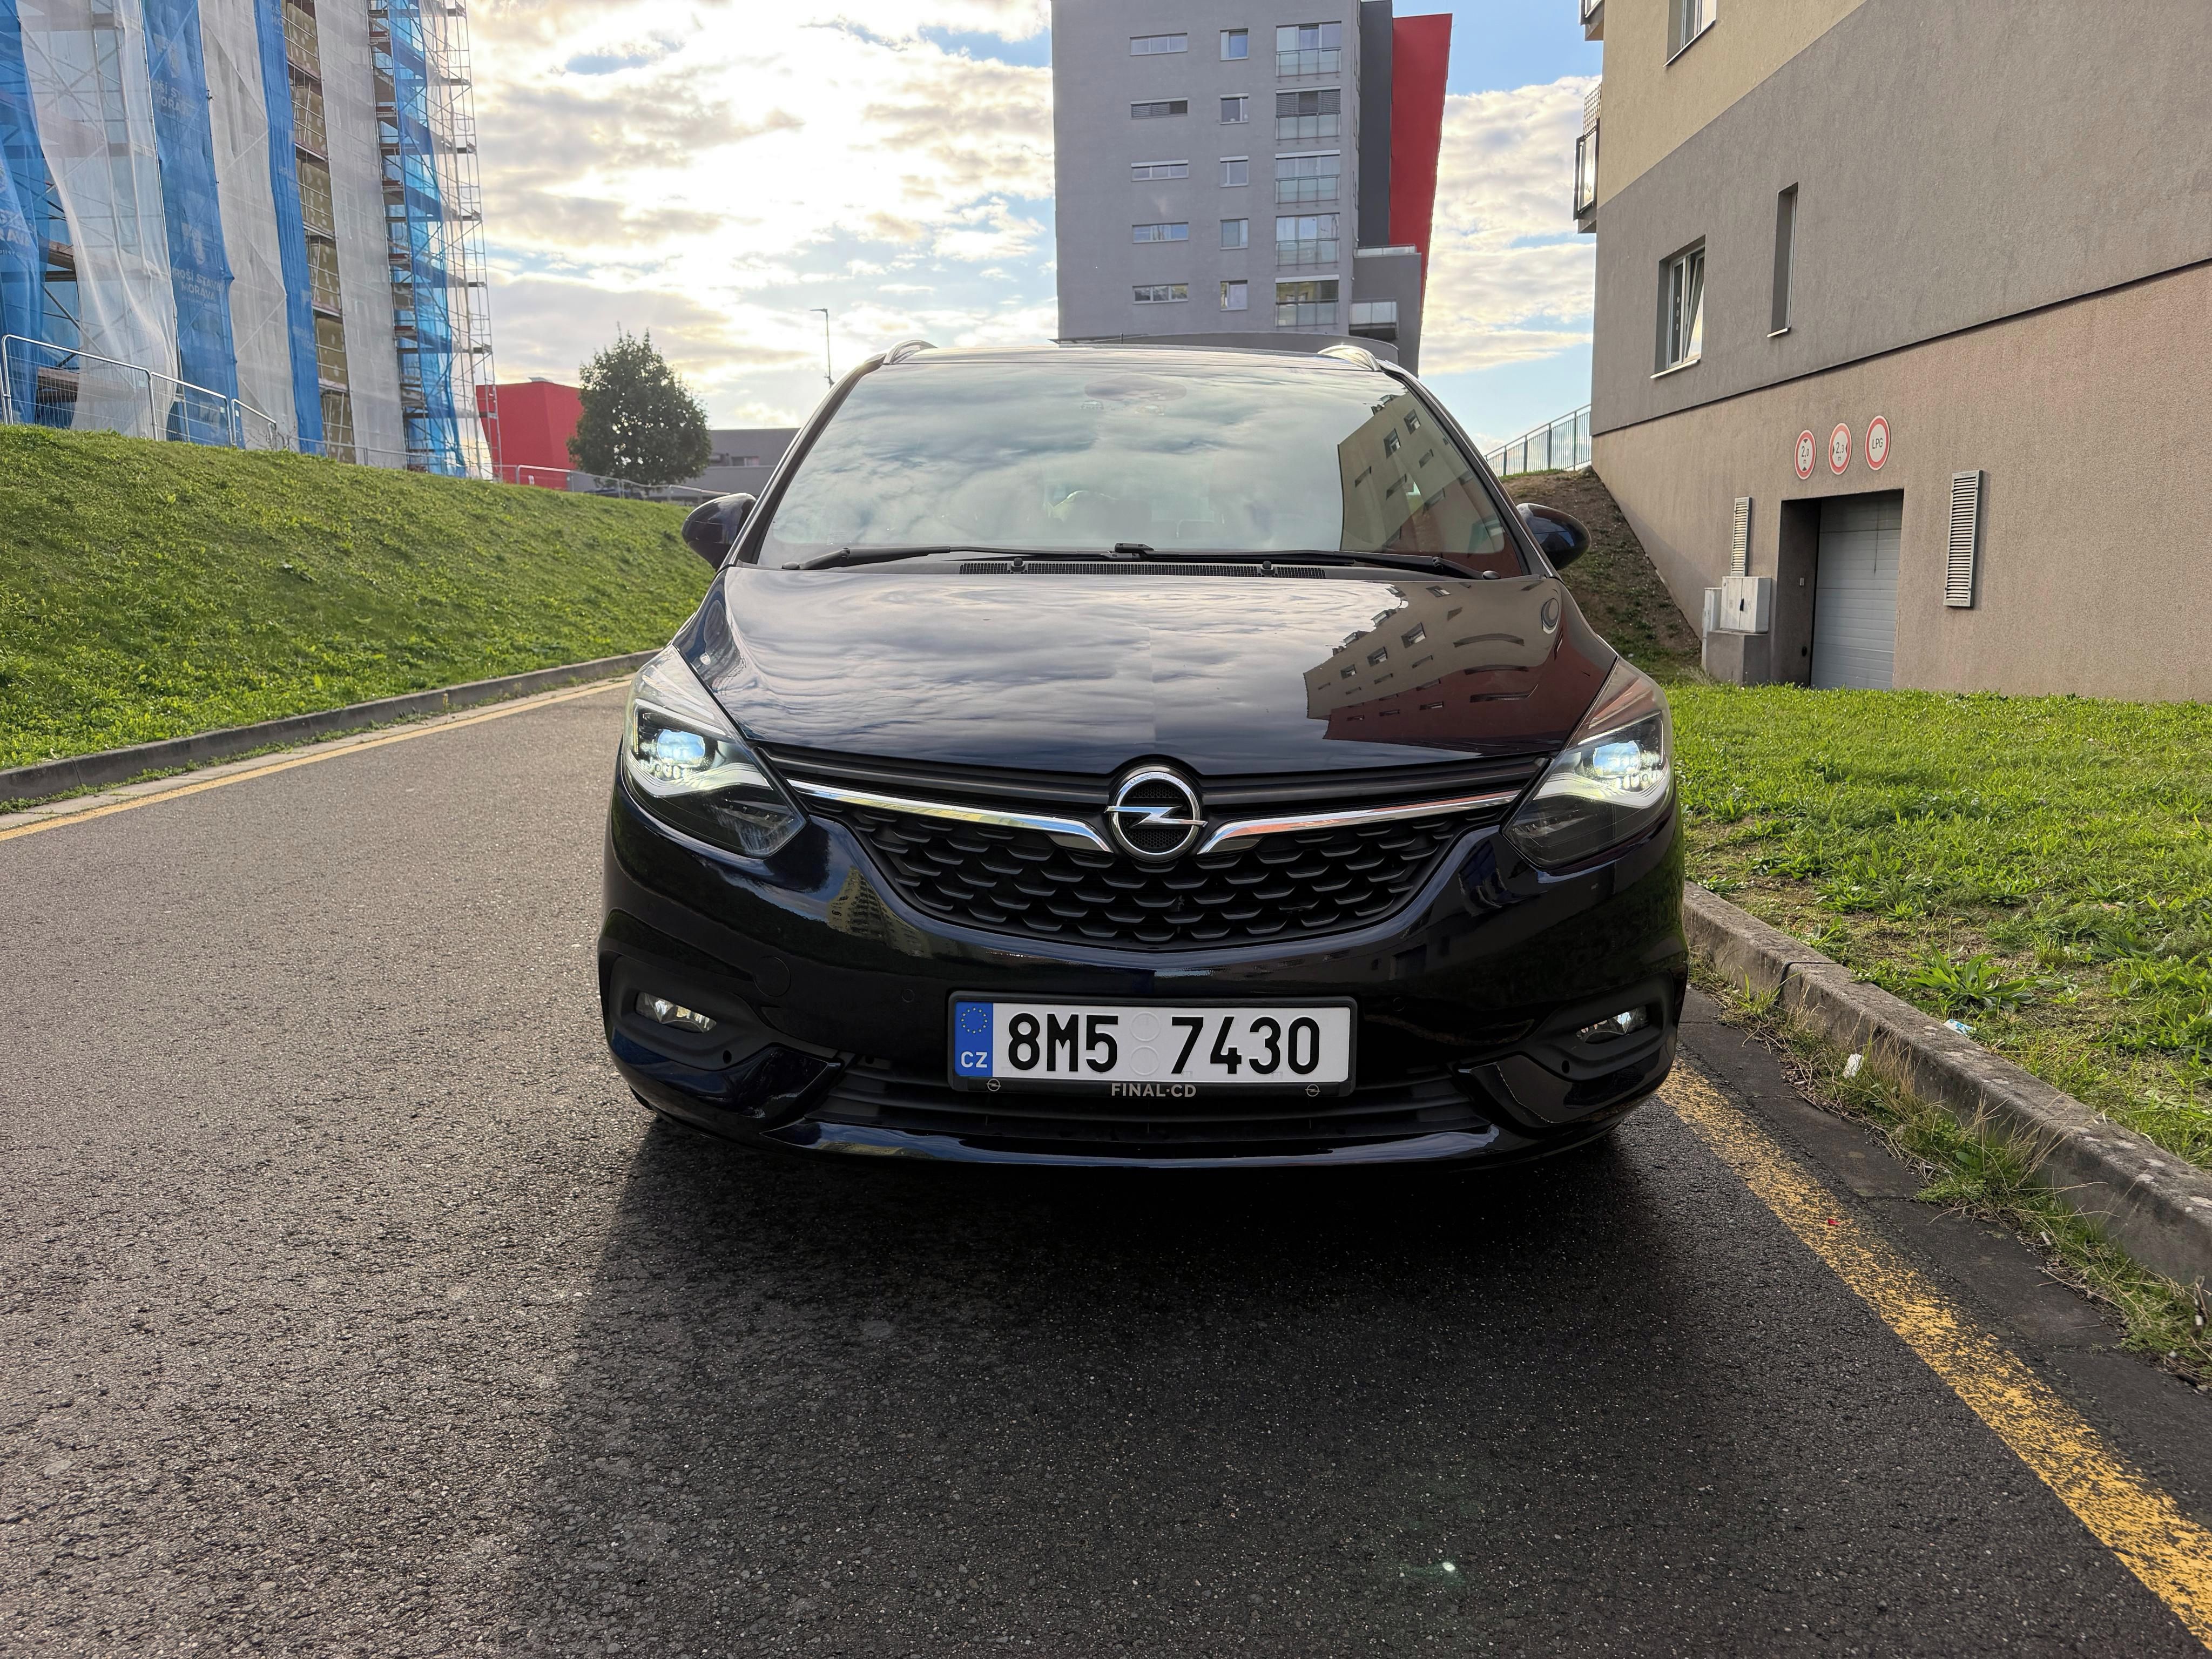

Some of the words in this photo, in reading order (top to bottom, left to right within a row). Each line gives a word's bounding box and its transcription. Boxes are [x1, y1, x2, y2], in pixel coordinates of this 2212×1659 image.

[181, 281, 216, 300] MORAVA
[1872, 437, 1883, 449] LPG
[1008, 1013, 1118, 1073] 8M5
[1171, 1016, 1320, 1075] 7430
[961, 1051, 987, 1068] CZ
